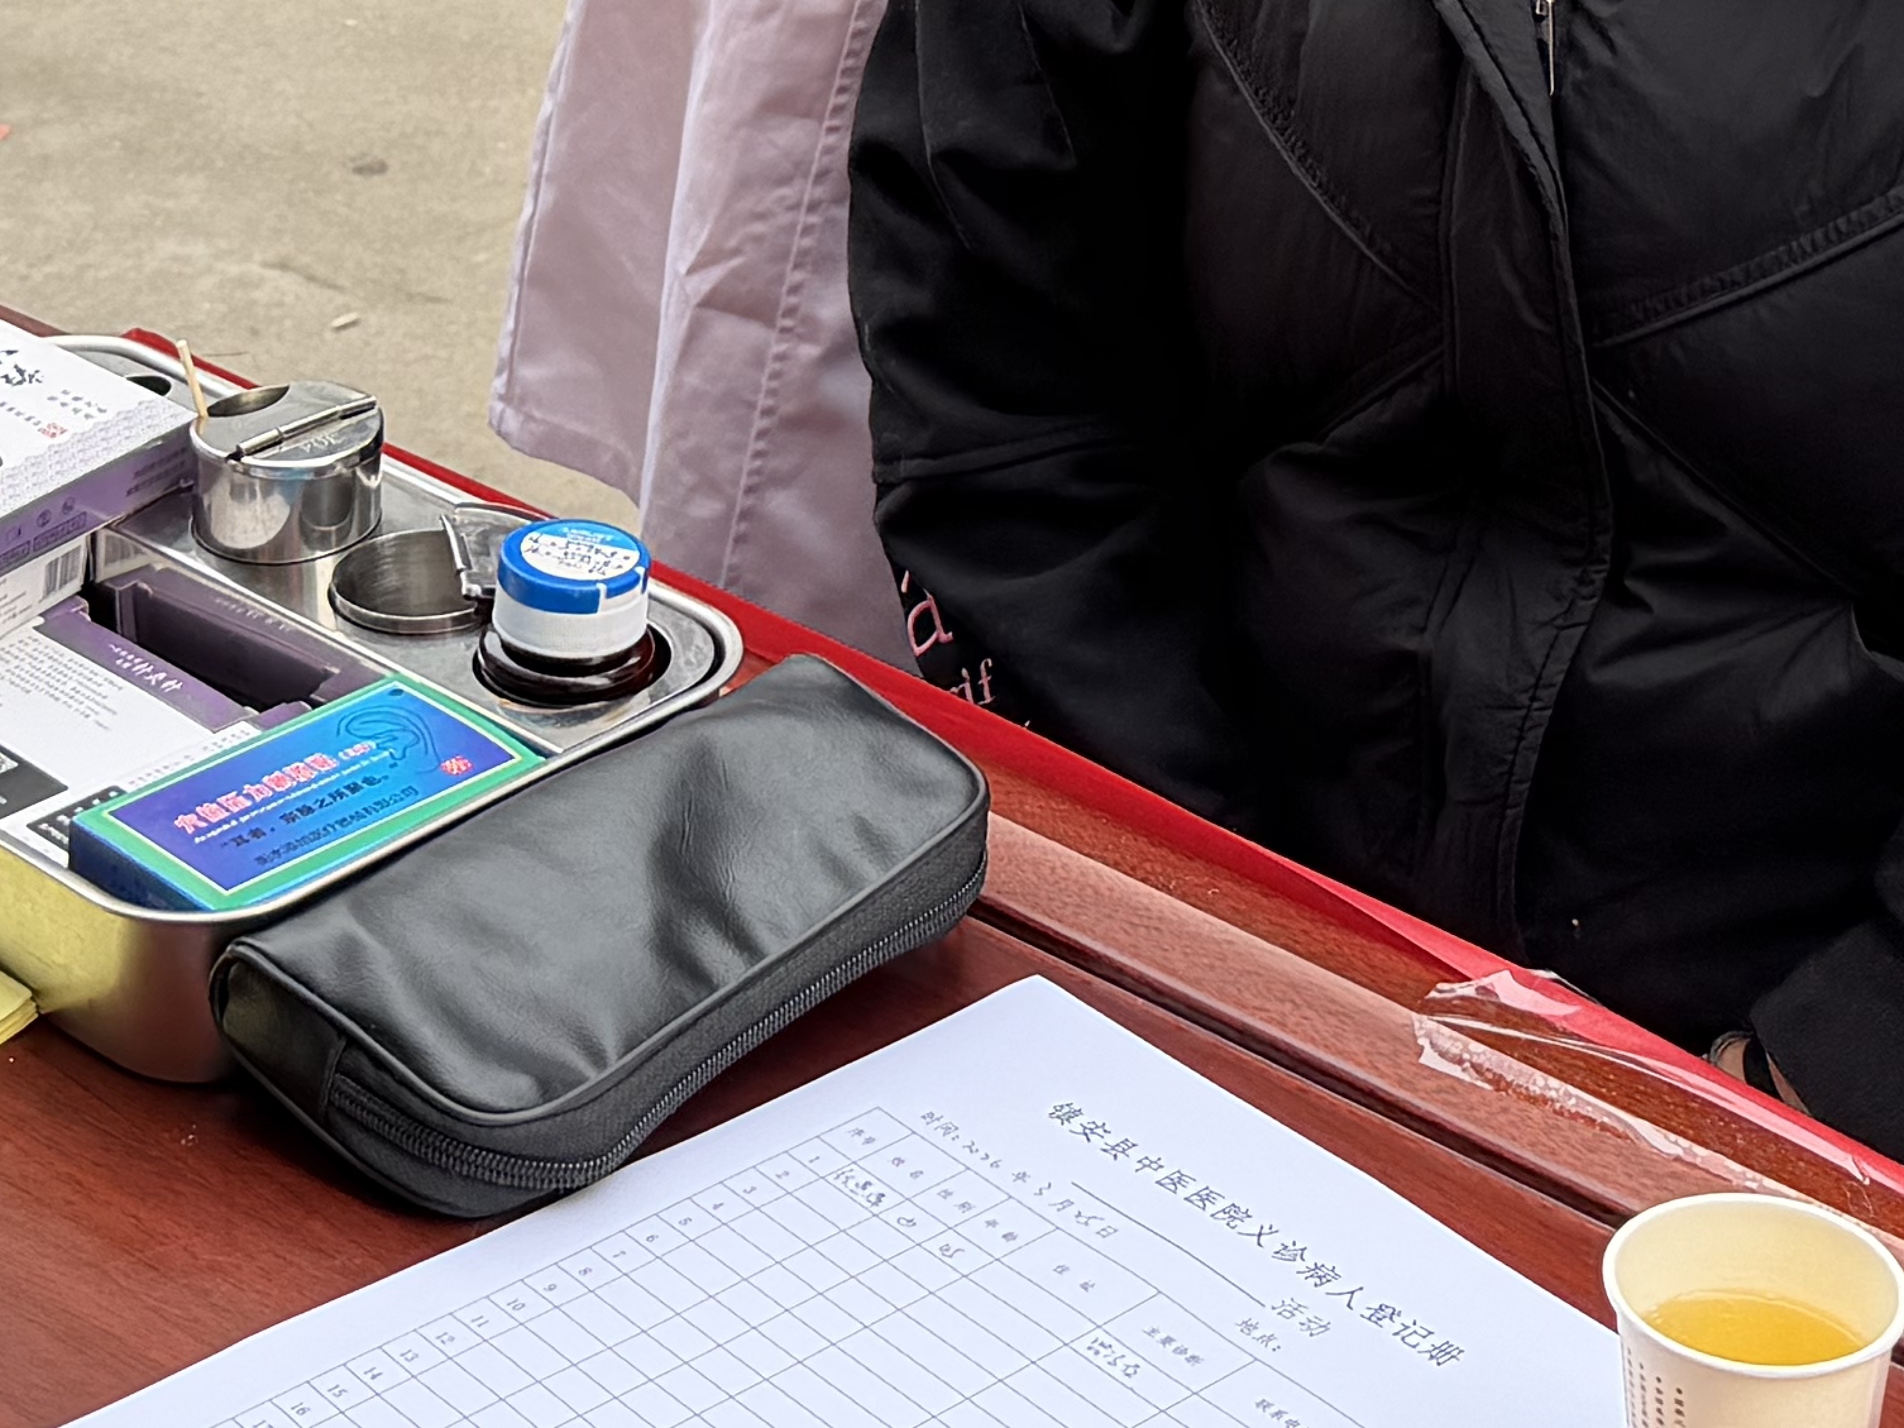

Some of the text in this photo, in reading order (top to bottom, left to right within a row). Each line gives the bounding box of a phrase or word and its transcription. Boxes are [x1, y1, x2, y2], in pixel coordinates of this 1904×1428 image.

[1047, 1101, 1466, 1368] 镇安县中医医院义诊病人登记册
[1271, 1297, 1332, 1338] 活动
